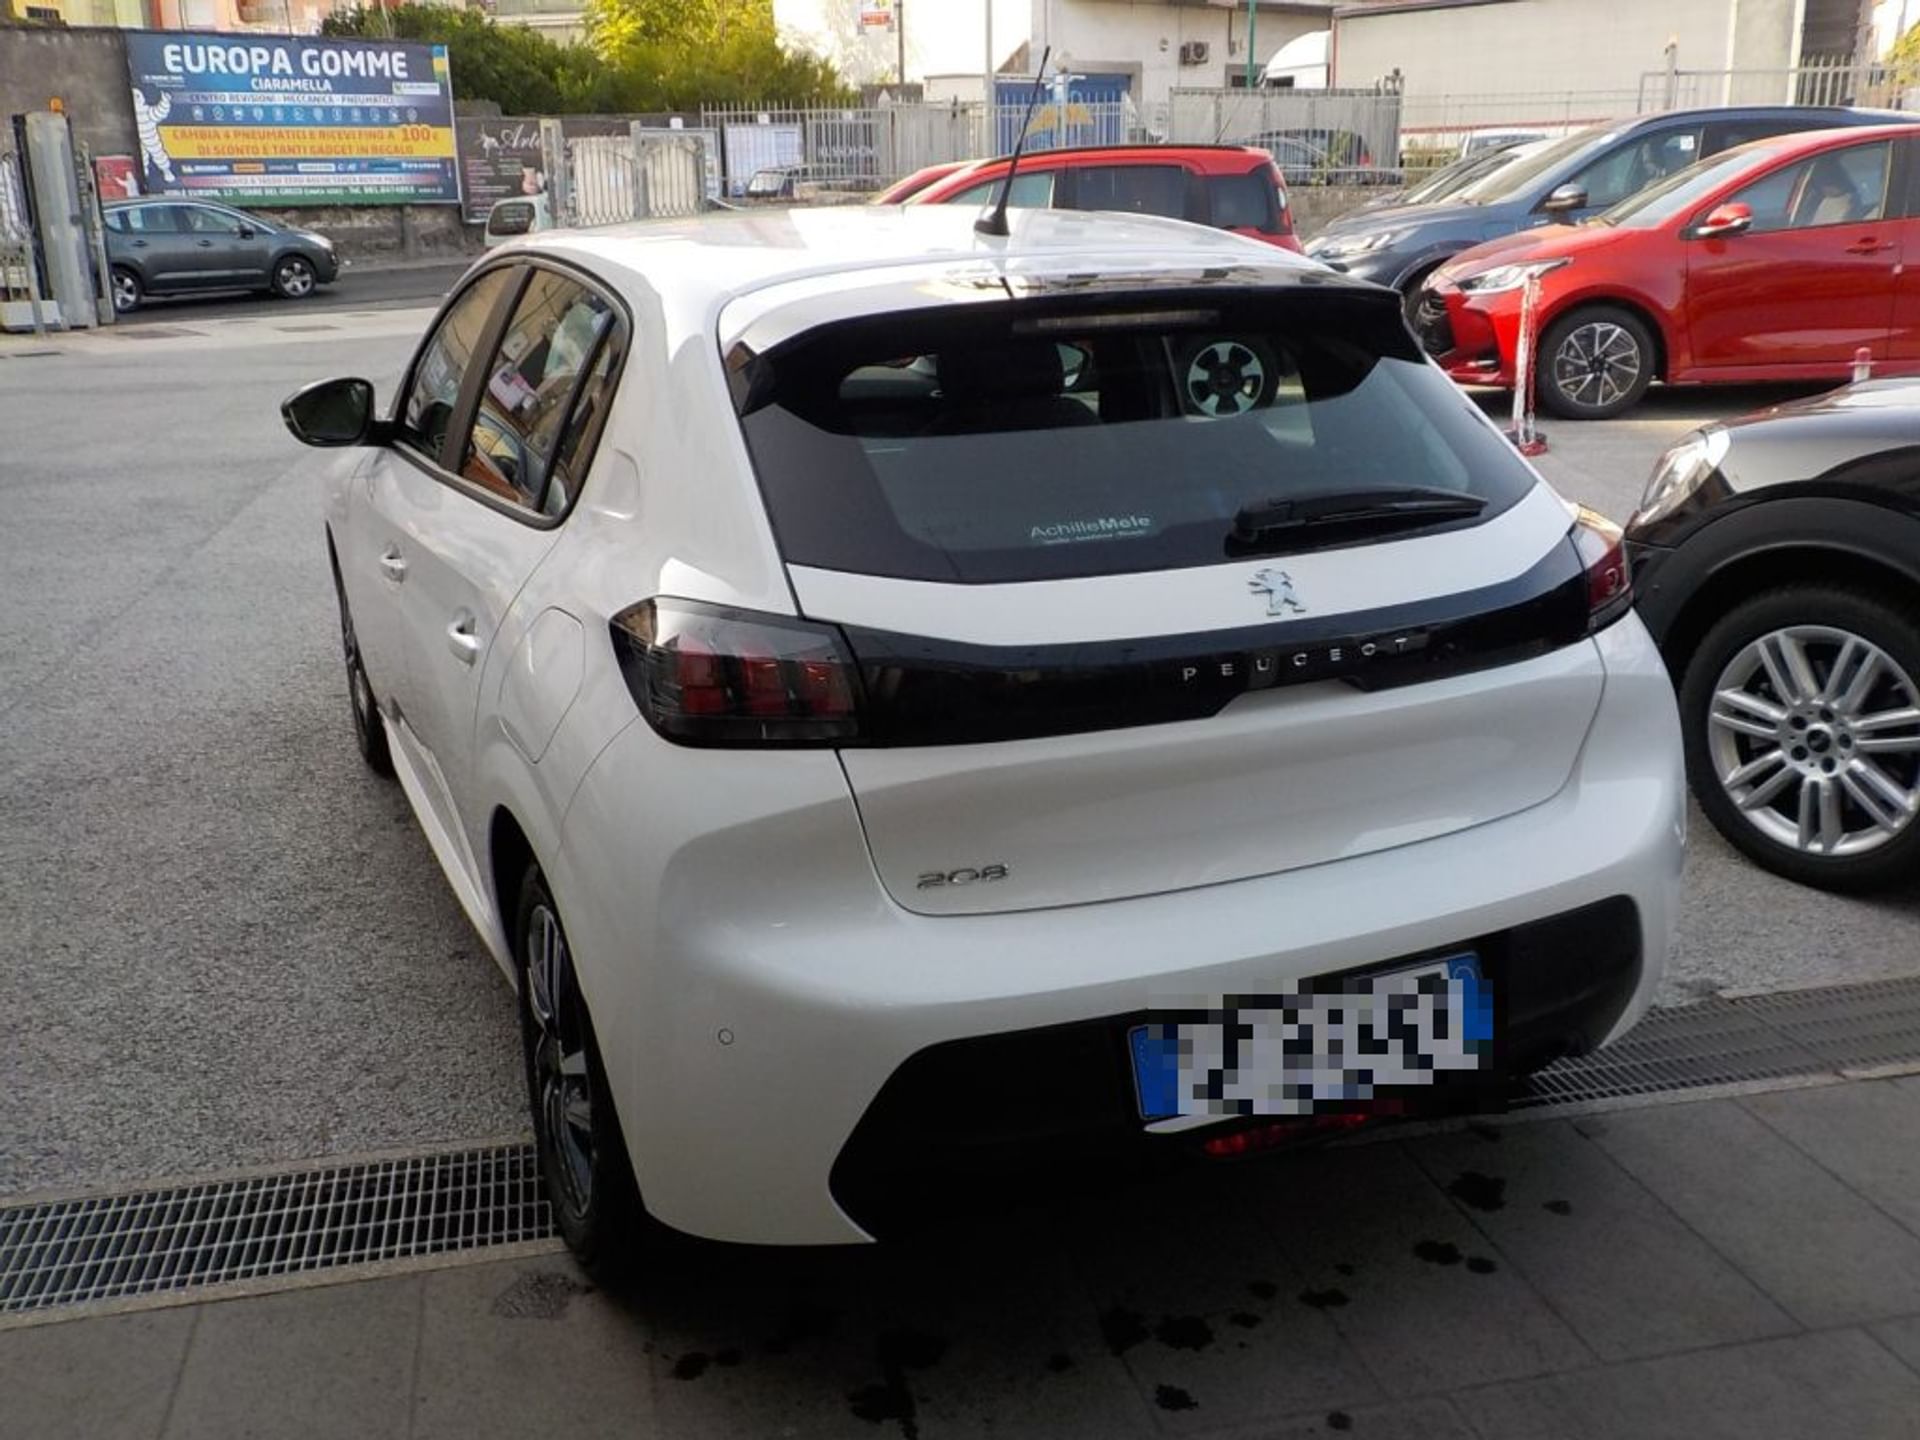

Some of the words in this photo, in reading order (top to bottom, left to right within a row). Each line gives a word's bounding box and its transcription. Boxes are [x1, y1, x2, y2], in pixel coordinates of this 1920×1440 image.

[164, 44, 294, 76] EUROPA
[301, 48, 408, 78] GOMME
[251, 77, 332, 92] CIARAMELLA
[173, 129, 221, 141] CAMBIA
[233, 130, 306, 141] PNEUMATICI
[1030, 514, 1151, 538] AchilleMele
[1183, 637, 1409, 682] PEUGEOT
[916, 864, 1009, 890] 208
